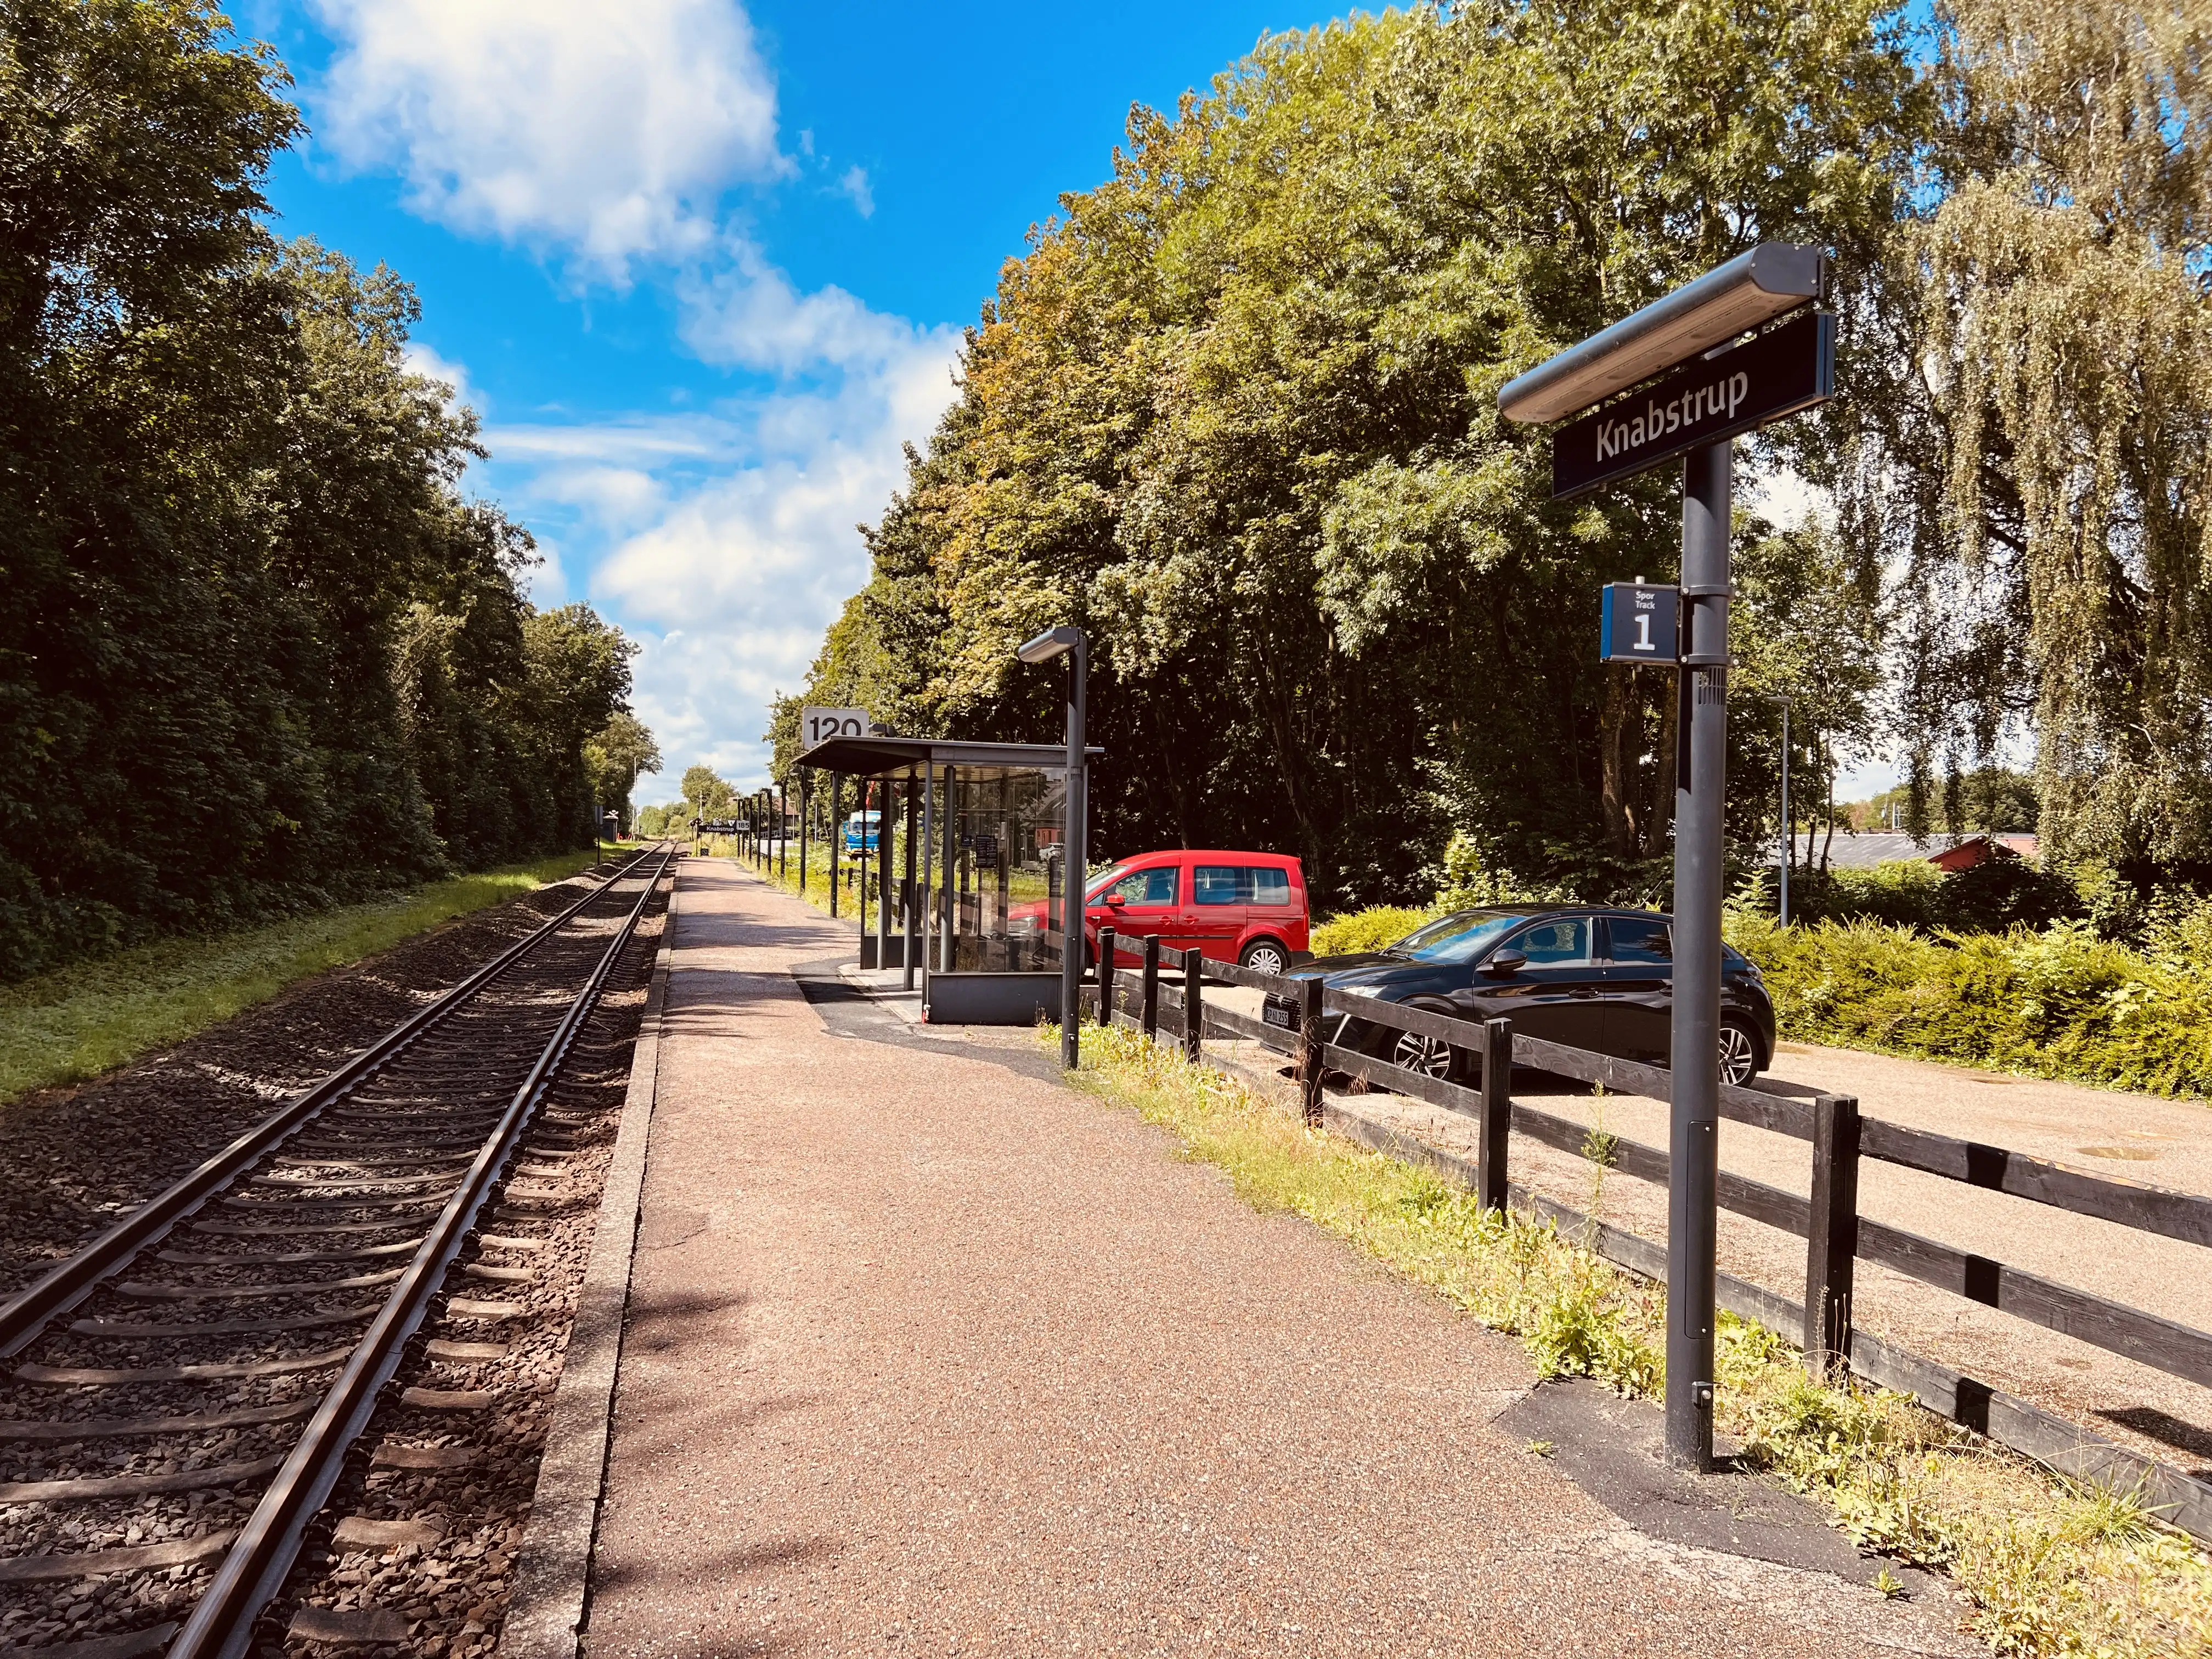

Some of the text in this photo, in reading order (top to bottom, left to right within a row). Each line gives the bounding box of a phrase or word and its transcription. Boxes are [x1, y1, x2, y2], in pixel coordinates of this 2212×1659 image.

[1597, 372, 1748, 462] Knabstrup
[1635, 591, 1655, 601] Spor
[1635, 601, 1655, 610] Track
[1634, 614, 1655, 650] 1
[810, 717, 861, 741] 120
[1273, 1011, 1277, 1021] 61
[1279, 1012, 1287, 1023] 255
